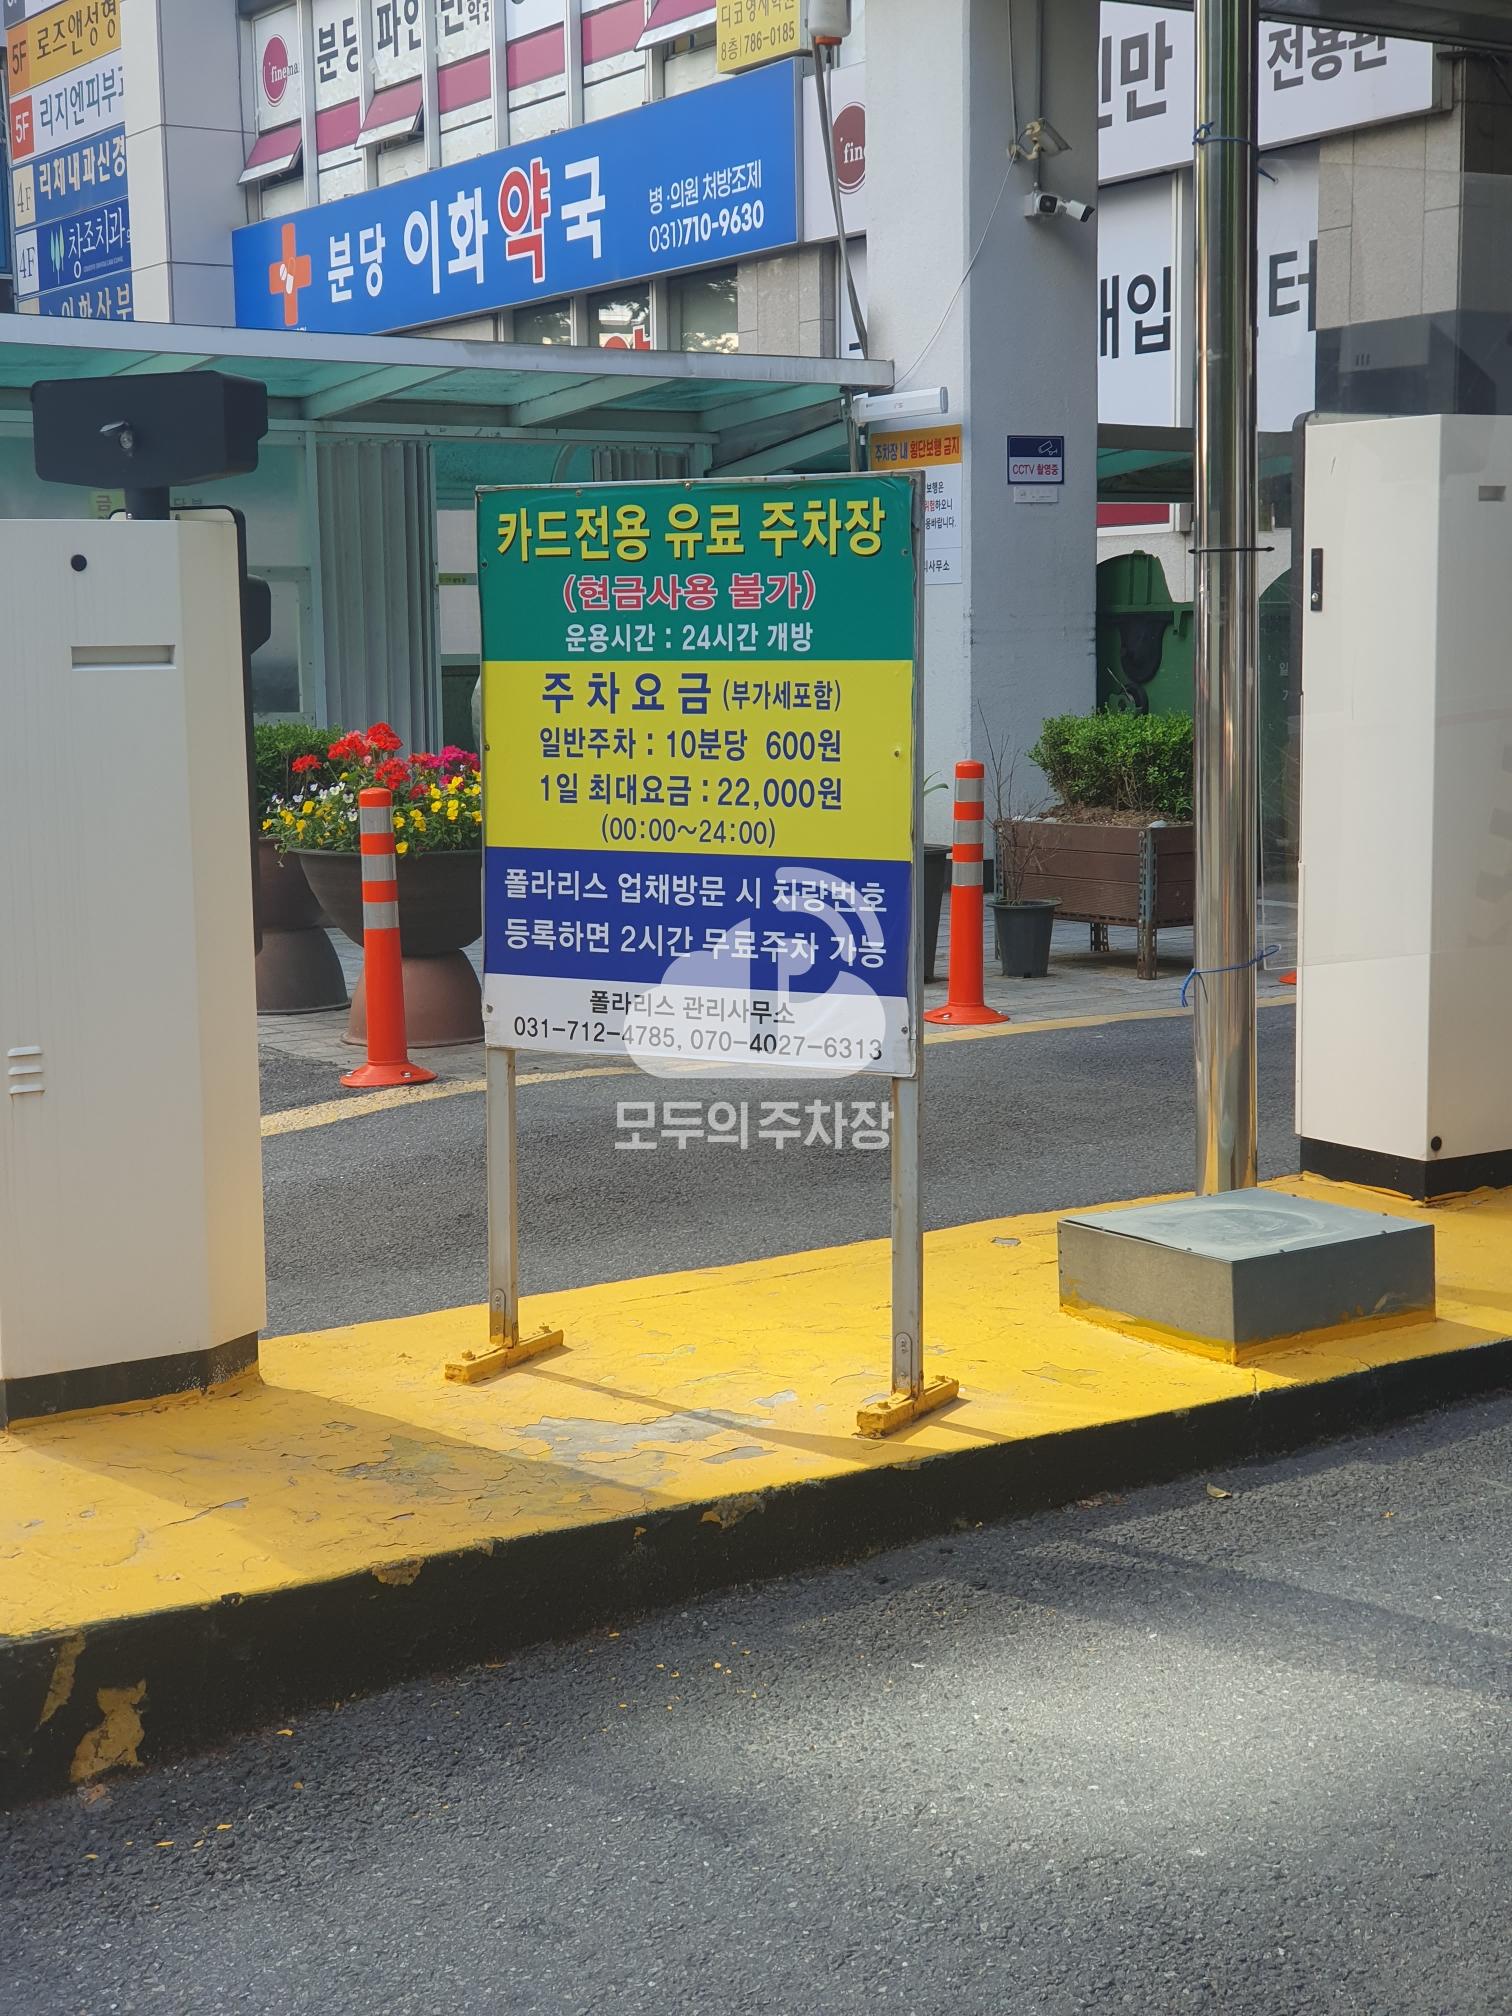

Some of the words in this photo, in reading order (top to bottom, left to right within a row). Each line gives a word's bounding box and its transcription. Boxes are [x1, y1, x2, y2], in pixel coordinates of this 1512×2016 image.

[744, 21, 795, 54] 786-0185
[12, 40, 27, 75] 5F
[15, 111, 30, 143] 5F
[17, 181, 31, 213] 4F
[702, 159, 762, 200] 처방조제
[649, 199, 764, 253] 031)710-9630
[19, 246, 35, 279] 4F
[327, 223, 387, 303] 분당
[944, 436, 960, 456] 금지
[1012, 464, 1035, 475] CCTV
[496, 504, 651, 563] 카드전용
[664, 503, 746, 560] 유료
[759, 496, 887, 558] 주차장
[562, 573, 719, 612] (현금사용
[728, 571, 817, 611] 불가)
[565, 624, 656, 653] 운용시간
[682, 623, 759, 652] 24시간
[767, 622, 814, 652] 개방
[722, 679, 842, 712] (부가세포함)
[540, 727, 636, 760] 일반주차
[667, 729, 748, 762] 10분당
[766, 729, 842, 763] 600원
[541, 774, 580, 805] 1일
[588, 774, 692, 807] 최대요금
[717, 777, 842, 812] 22,000원
[504, 868, 609, 901] 폴라리스
[618, 873, 726, 907] 업채방문
[735, 877, 762, 910] 시
[772, 879, 888, 913] 차량번호
[504, 918, 610, 953] 등록하면
[620, 924, 694, 958] 2시간
[702, 928, 819, 966] 무료주차
[829, 934, 887, 969] 가능
[589, 990, 676, 1017] 폴라리스
[682, 996, 796, 1025] 관리사무소
[691, 1029, 882, 1060] 070-4027-6313
